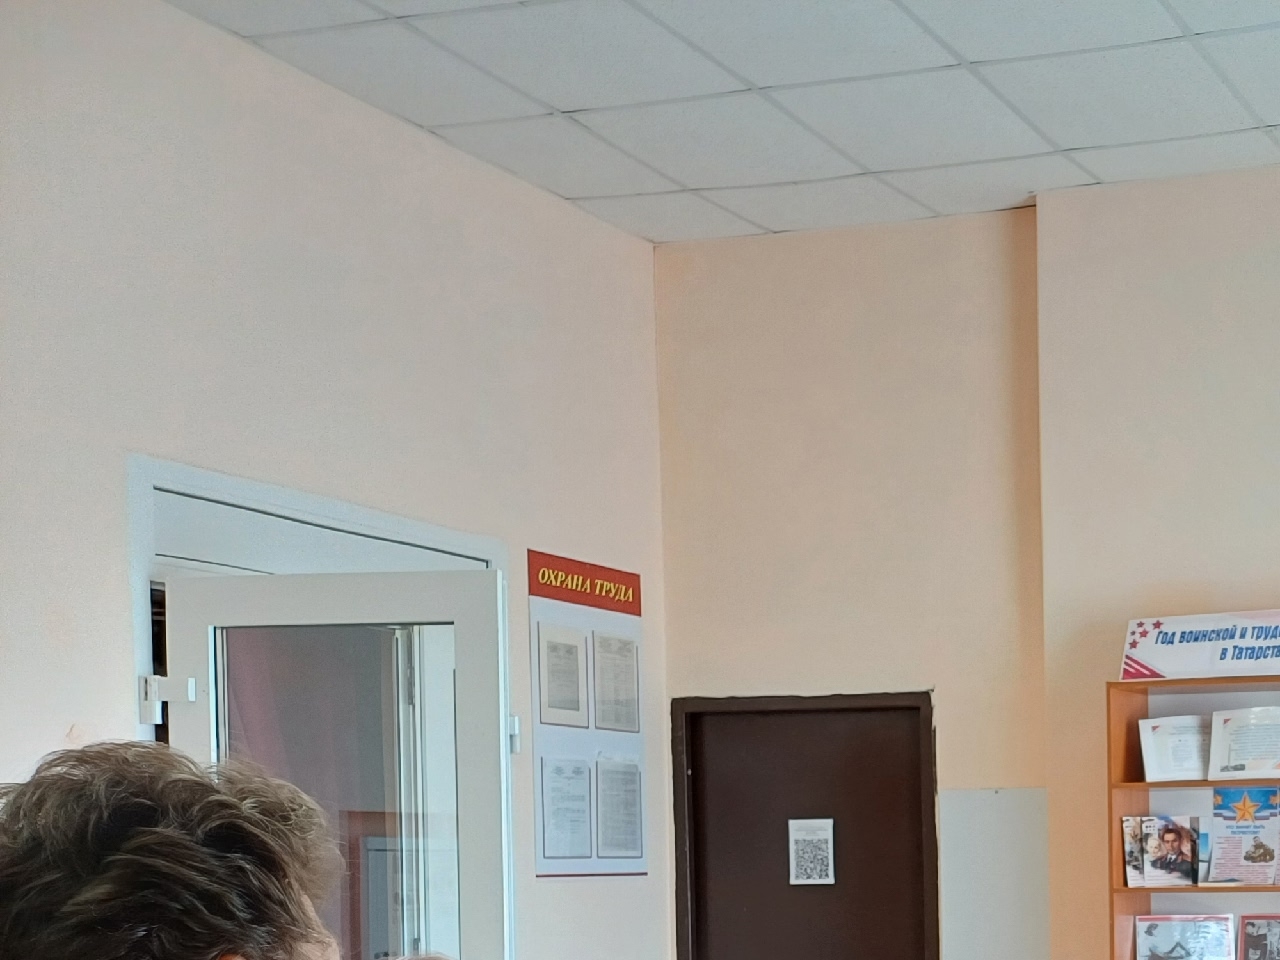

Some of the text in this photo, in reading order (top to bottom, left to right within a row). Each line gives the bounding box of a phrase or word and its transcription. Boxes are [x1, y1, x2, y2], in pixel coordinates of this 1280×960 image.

[538, 567, 634, 603] ОХРАНА ТРУДА
[1155, 630, 1177, 646] Год
[1178, 624, 1238, 644] воинской
[1239, 626, 1248, 640] и
[1219, 647, 1229, 661] в
